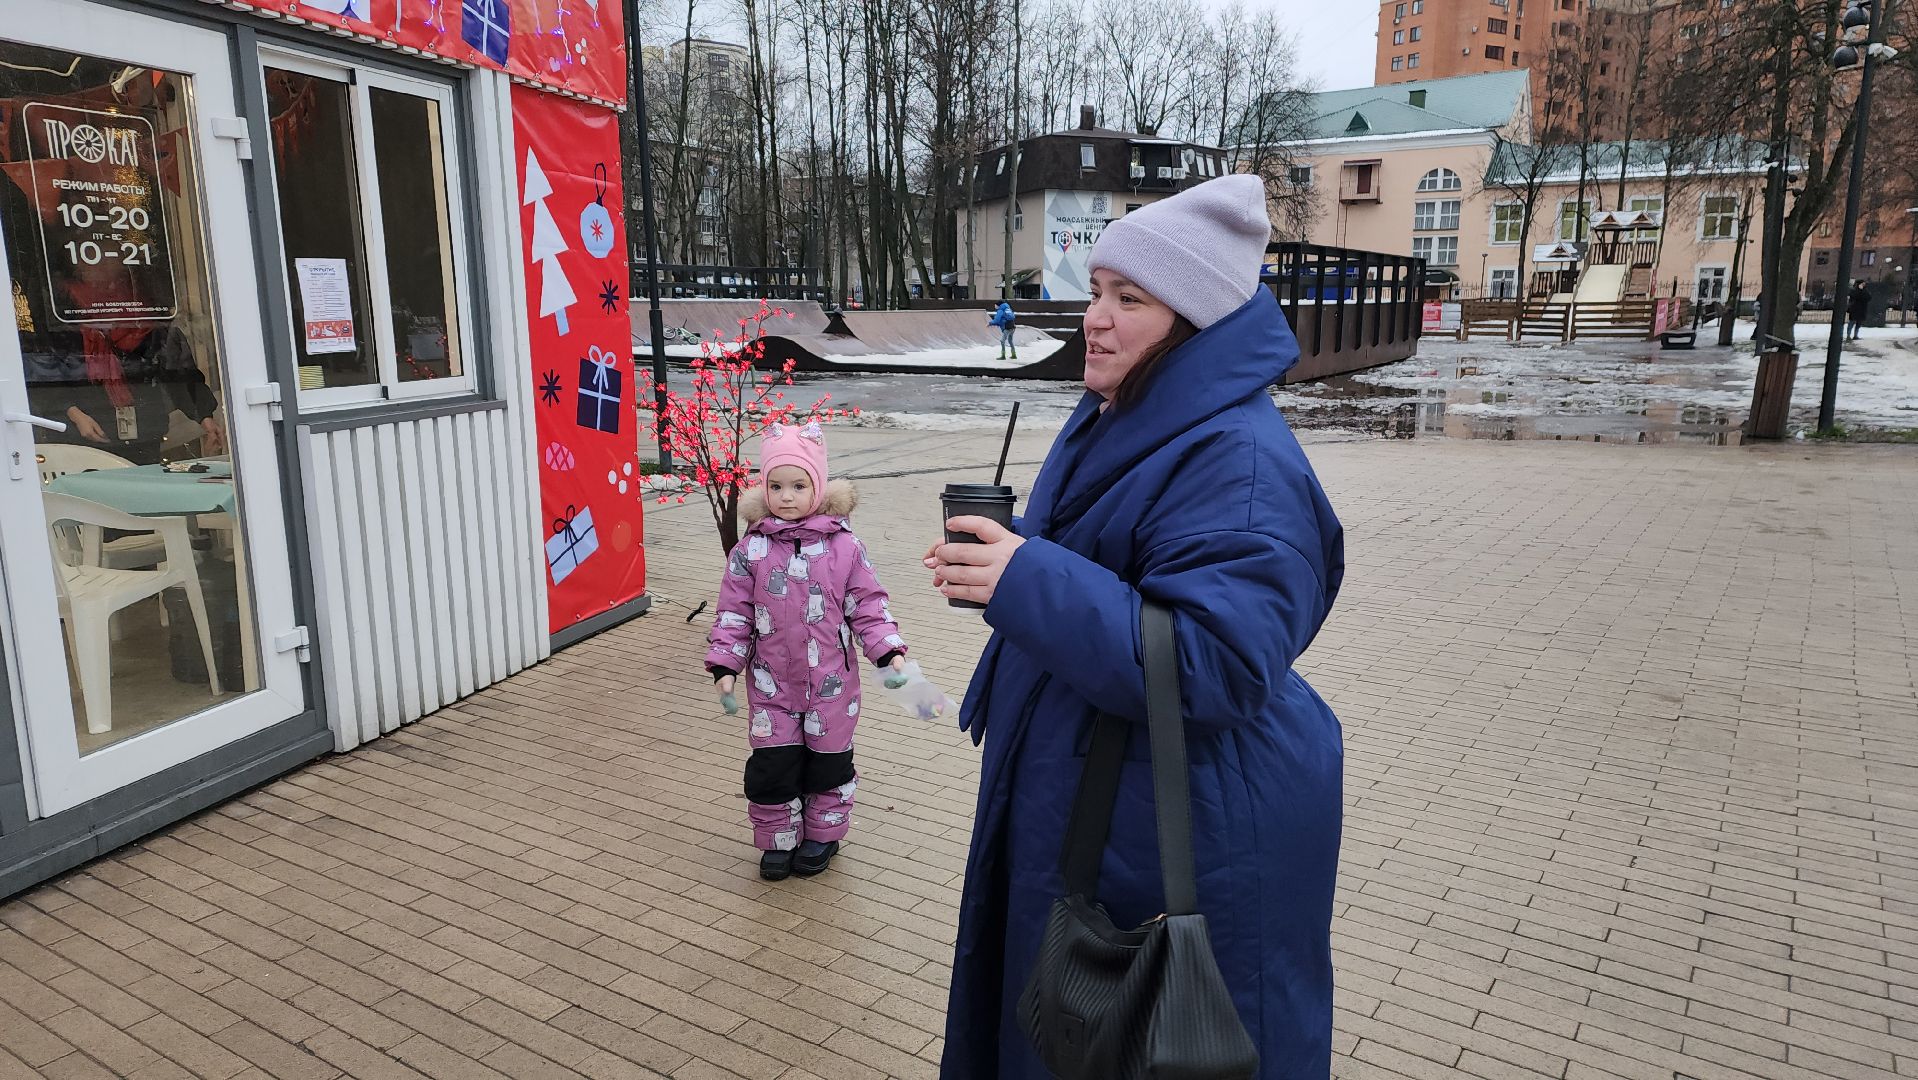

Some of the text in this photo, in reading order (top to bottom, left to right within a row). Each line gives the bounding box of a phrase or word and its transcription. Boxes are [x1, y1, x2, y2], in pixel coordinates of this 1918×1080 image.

[43, 119, 139, 167] ПРОКАТ
[52, 179, 145, 195] РЕЖИМ РАБОТЫ
[57, 203, 149, 230] 10-20
[64, 241, 151, 265] 10-21
